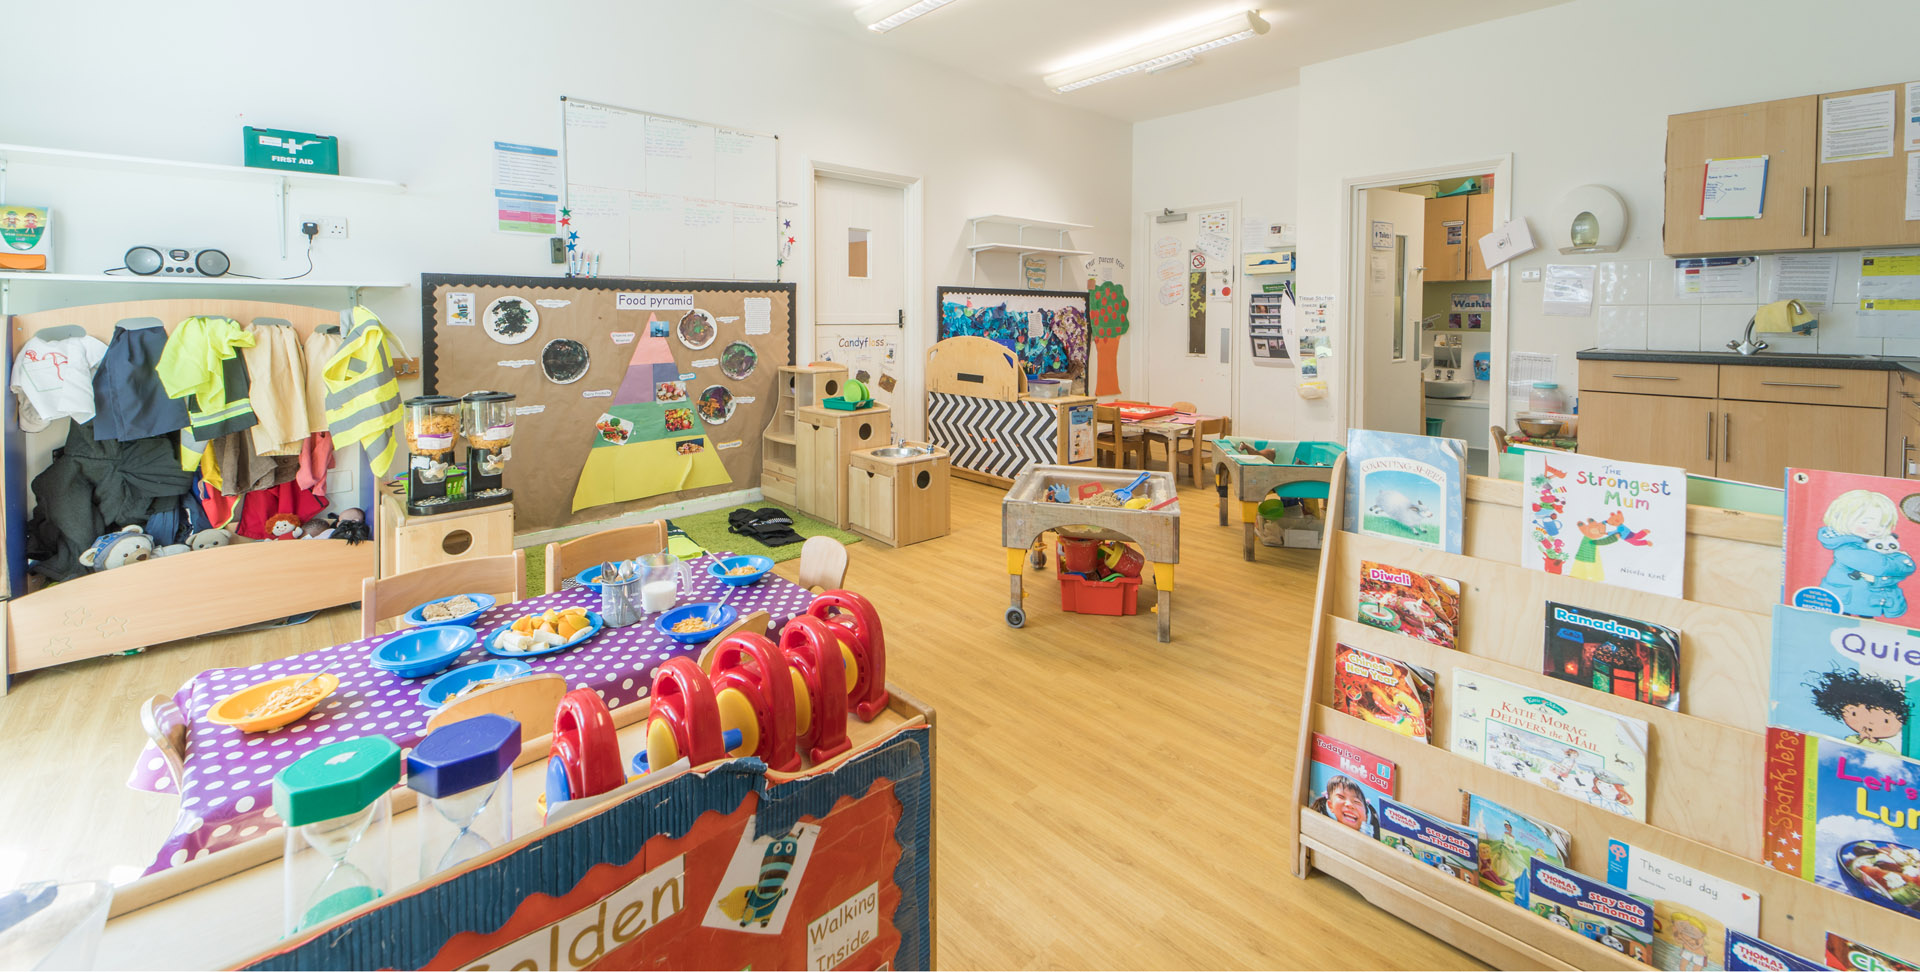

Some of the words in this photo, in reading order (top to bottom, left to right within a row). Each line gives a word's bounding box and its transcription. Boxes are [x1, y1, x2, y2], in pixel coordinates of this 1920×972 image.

[271, 155, 297, 164] FIRST
[1085, 258, 1096, 270] Our
[1098, 256, 1114, 265] parent
[1115, 258, 1125, 270] tree
[618, 294, 646, 305] Food
[650, 295, 693, 308] pyramid
[838, 337, 885, 349] Candyfloss
[1361, 460, 1412, 473] COUNTING
[1602, 464, 1621, 476] THE
[1576, 470, 1671, 497] Strongest
[1604, 490, 1650, 511] Mum
[1370, 569, 1411, 586] Diwali
[1620, 567, 1645, 577] Nicola
[1648, 573, 1666, 581] Kent
[1555, 607, 1640, 640] Ramadan
[1345, 662, 1369, 677] New
[1370, 669, 1398, 686] Year
[1348, 653, 1393, 675] Chinese
[1490, 708, 1547, 735] DELIVERS
[1549, 730, 1564, 740] the
[1566, 733, 1600, 752] MAIL
[1501, 701, 1537, 721] KATIE
[1540, 714, 1588, 738] MORAG
[1316, 738, 1343, 756] Today
[1345, 749, 1352, 758] is
[1340, 756, 1368, 779] Hot
[1369, 773, 1389, 790] Day
[1768, 731, 1803, 830] Sparklers
[1836, 756, 1918, 800] Let's
[1388, 809, 1417, 826] THOMAS
[1417, 833, 1430, 842] with
[1430, 836, 1471, 857] Thomas
[1425, 827, 1447, 840] Stay
[1448, 835, 1470, 849] Safe
[1541, 871, 1577, 891] THOMAS
[1549, 880, 1575, 894] FRIENDS
[1640, 857, 1661, 875] The
[1667, 872, 1692, 887] cold
[1699, 884, 1718, 900] day
[1577, 900, 1594, 909] with
[1594, 902, 1645, 927] Thomas
[1588, 891, 1616, 906] Stay
[1618, 900, 1645, 917] Safe
[466, 877, 681, 971] lden
[810, 892, 876, 945] Walking
[816, 930, 870, 971] Inside
[1738, 945, 1784, 970] THOMAS
